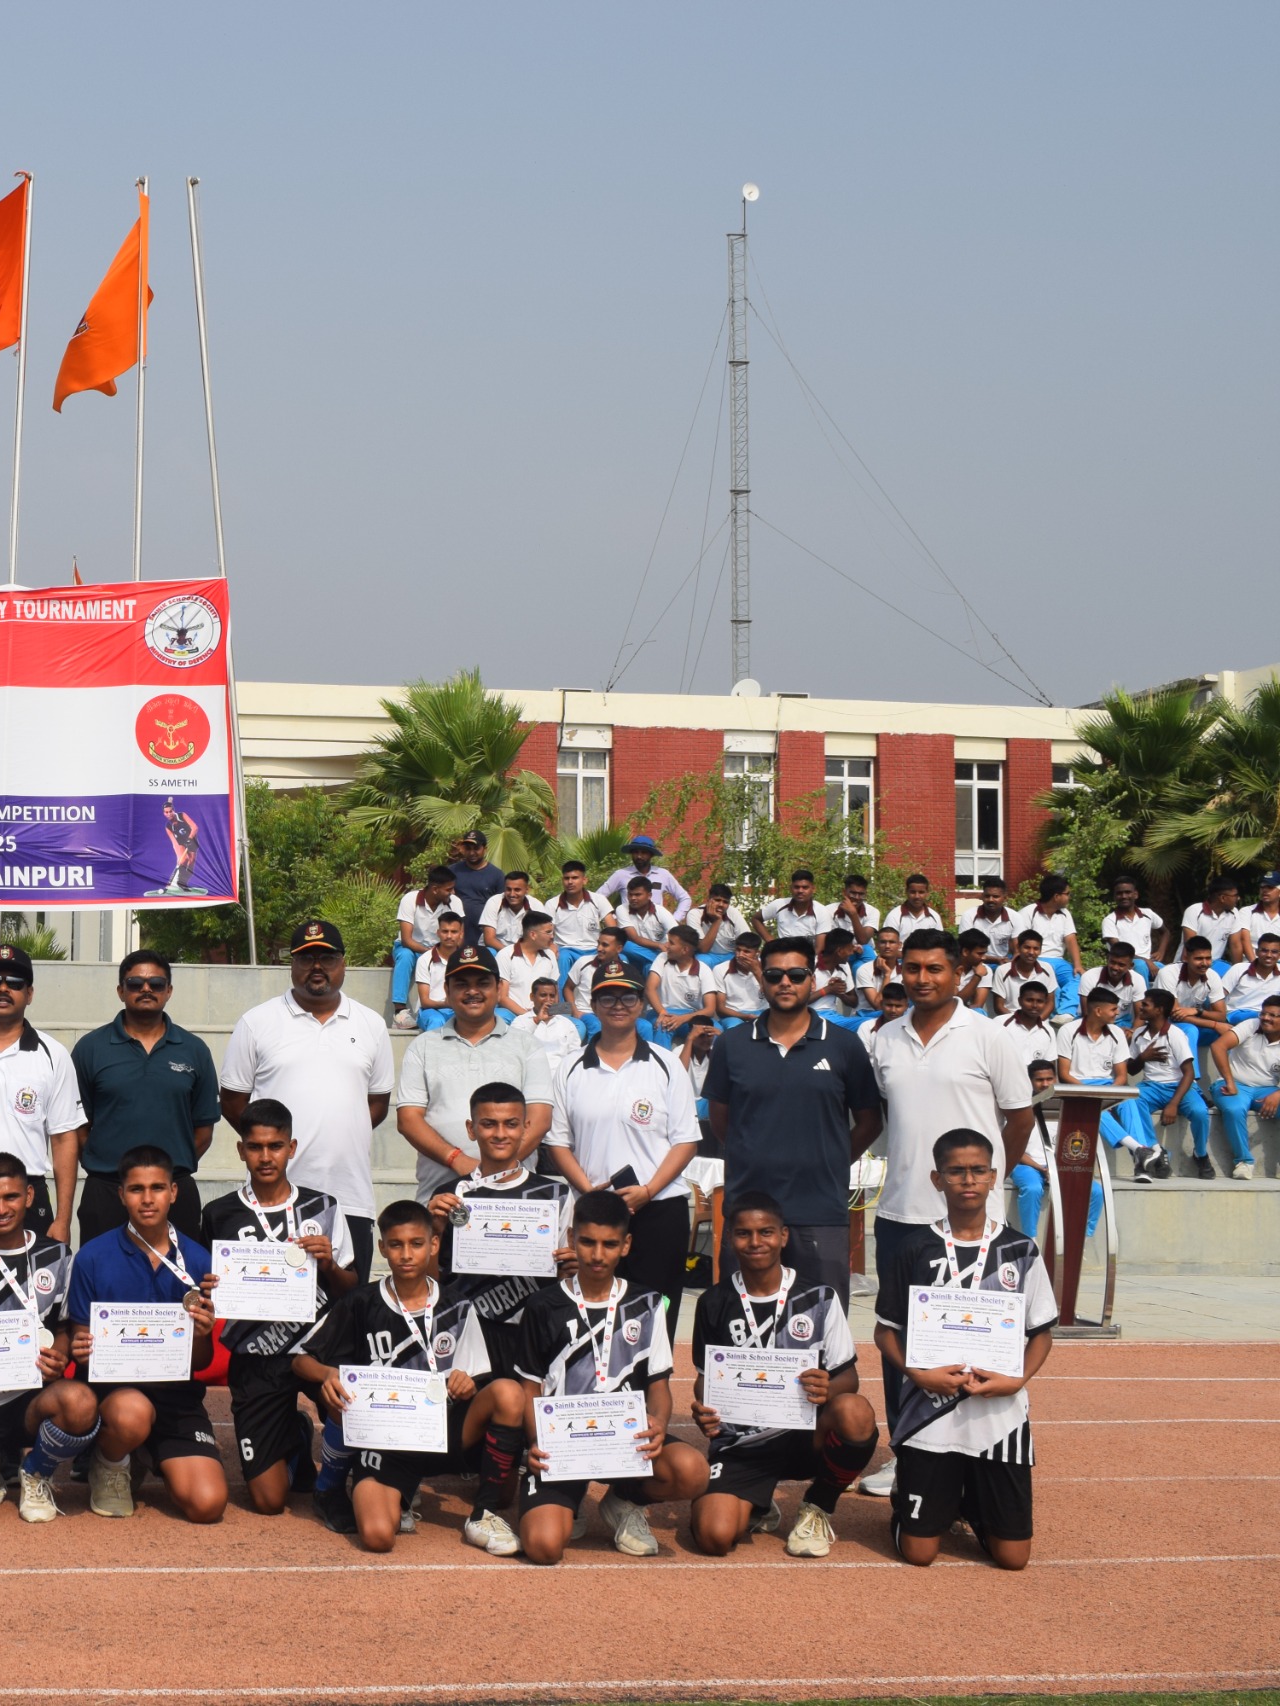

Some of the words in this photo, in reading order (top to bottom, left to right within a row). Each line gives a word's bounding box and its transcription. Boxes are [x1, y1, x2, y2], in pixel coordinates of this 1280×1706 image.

[13, 599, 136, 620] TOURNAMENT
[148, 779, 159, 787] SS
[161, 779, 198, 787] AMETHI
[929, 1257, 948, 1286] 7
[931, 1292, 952, 1300] Sainik
[954, 1294, 978, 1302] School
[980, 1296, 1005, 1305] Society
[155, 1309, 177, 1317] Society
[566, 1318, 578, 1345] 1
[729, 1318, 746, 1346] 8
[366, 1330, 392, 1361] 10
[726, 1352, 747, 1360] Sainik
[774, 1355, 799, 1363] Society
[358, 1372, 379, 1380] Sainik
[404, 1375, 427, 1384] Society
[602, 1399, 625, 1407] Society
[240, 1438, 254, 1462] 6
[361, 1451, 382, 1471] 10
[527, 1476, 537, 1496] 1
[908, 1494, 923, 1520] 7
